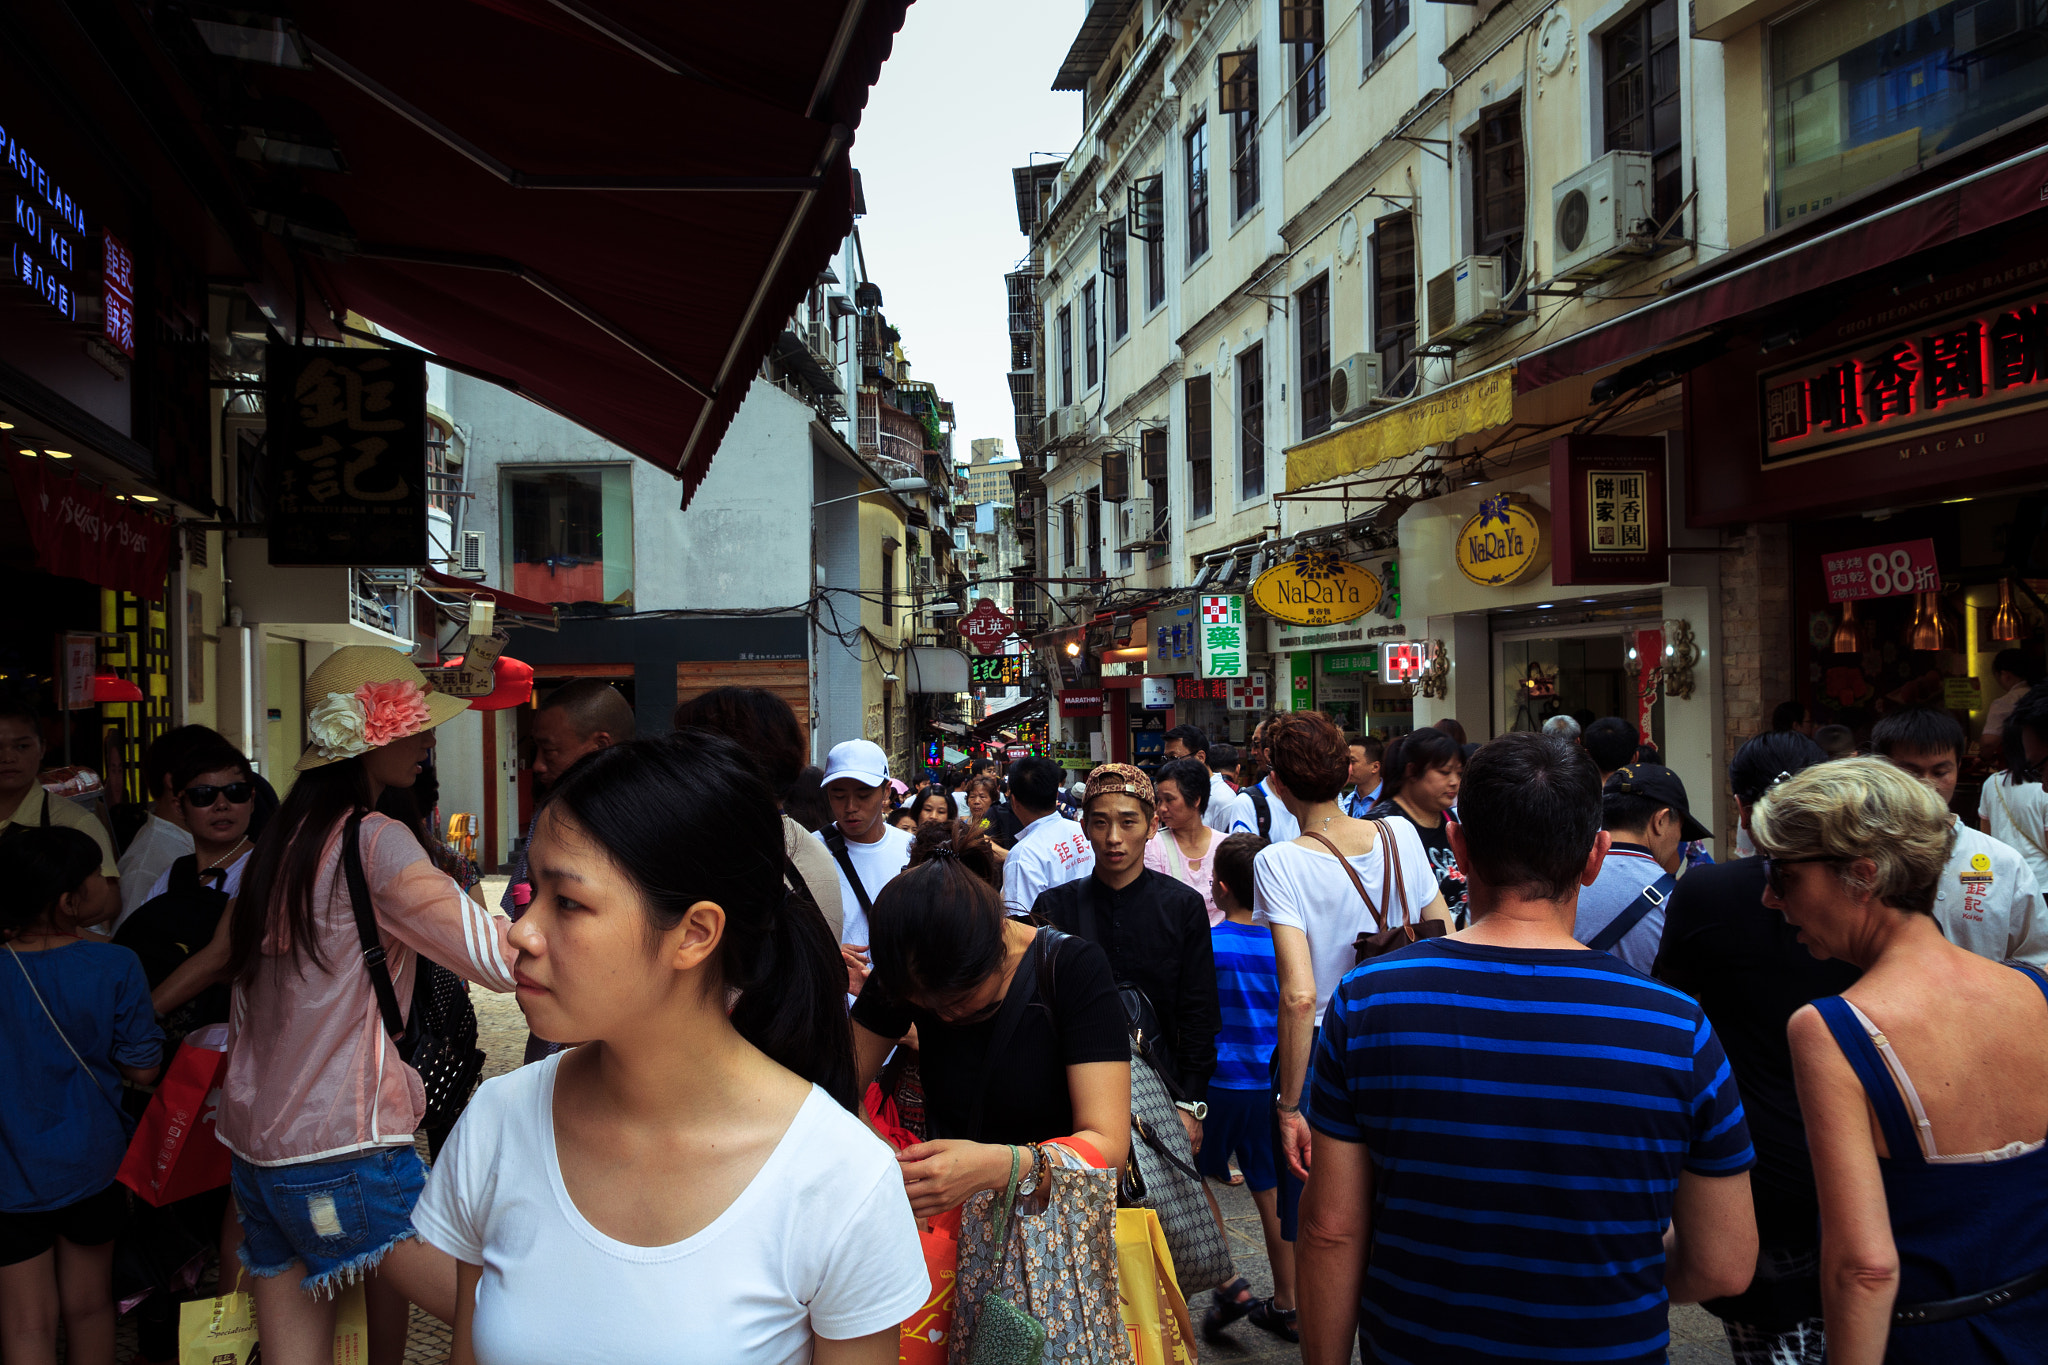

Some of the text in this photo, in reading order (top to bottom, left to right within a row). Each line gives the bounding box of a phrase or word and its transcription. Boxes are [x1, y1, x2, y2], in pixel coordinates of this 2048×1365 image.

[0, 124, 87, 238] PASTELARIA
[15, 194, 73, 272] KOI KEI
[12, 242, 76, 322] (第八分店)
[104, 234, 135, 294] 鉅記
[104, 292, 135, 350] 餅家
[1836, 258, 2048, 337] CHOI HEONG YUEN BAKERY
[294, 356, 411, 504] 鉅記
[1899, 432, 1986, 460] MACAU
[1595, 478, 1615, 522] 餅家
[1620, 478, 1641, 546] 咀香園
[1469, 527, 1524, 565] NaRaYa
[1827, 556, 1863, 572] 鮮烤
[1277, 579, 1361, 604] NaRaYa
[1831, 570, 1867, 586] 肉乾
[1866, 549, 1916, 596] 88
[1914, 564, 1936, 590] 折
[1206, 626, 1242, 676] 藥房
[1064, 696, 1101, 704] MARATHON
